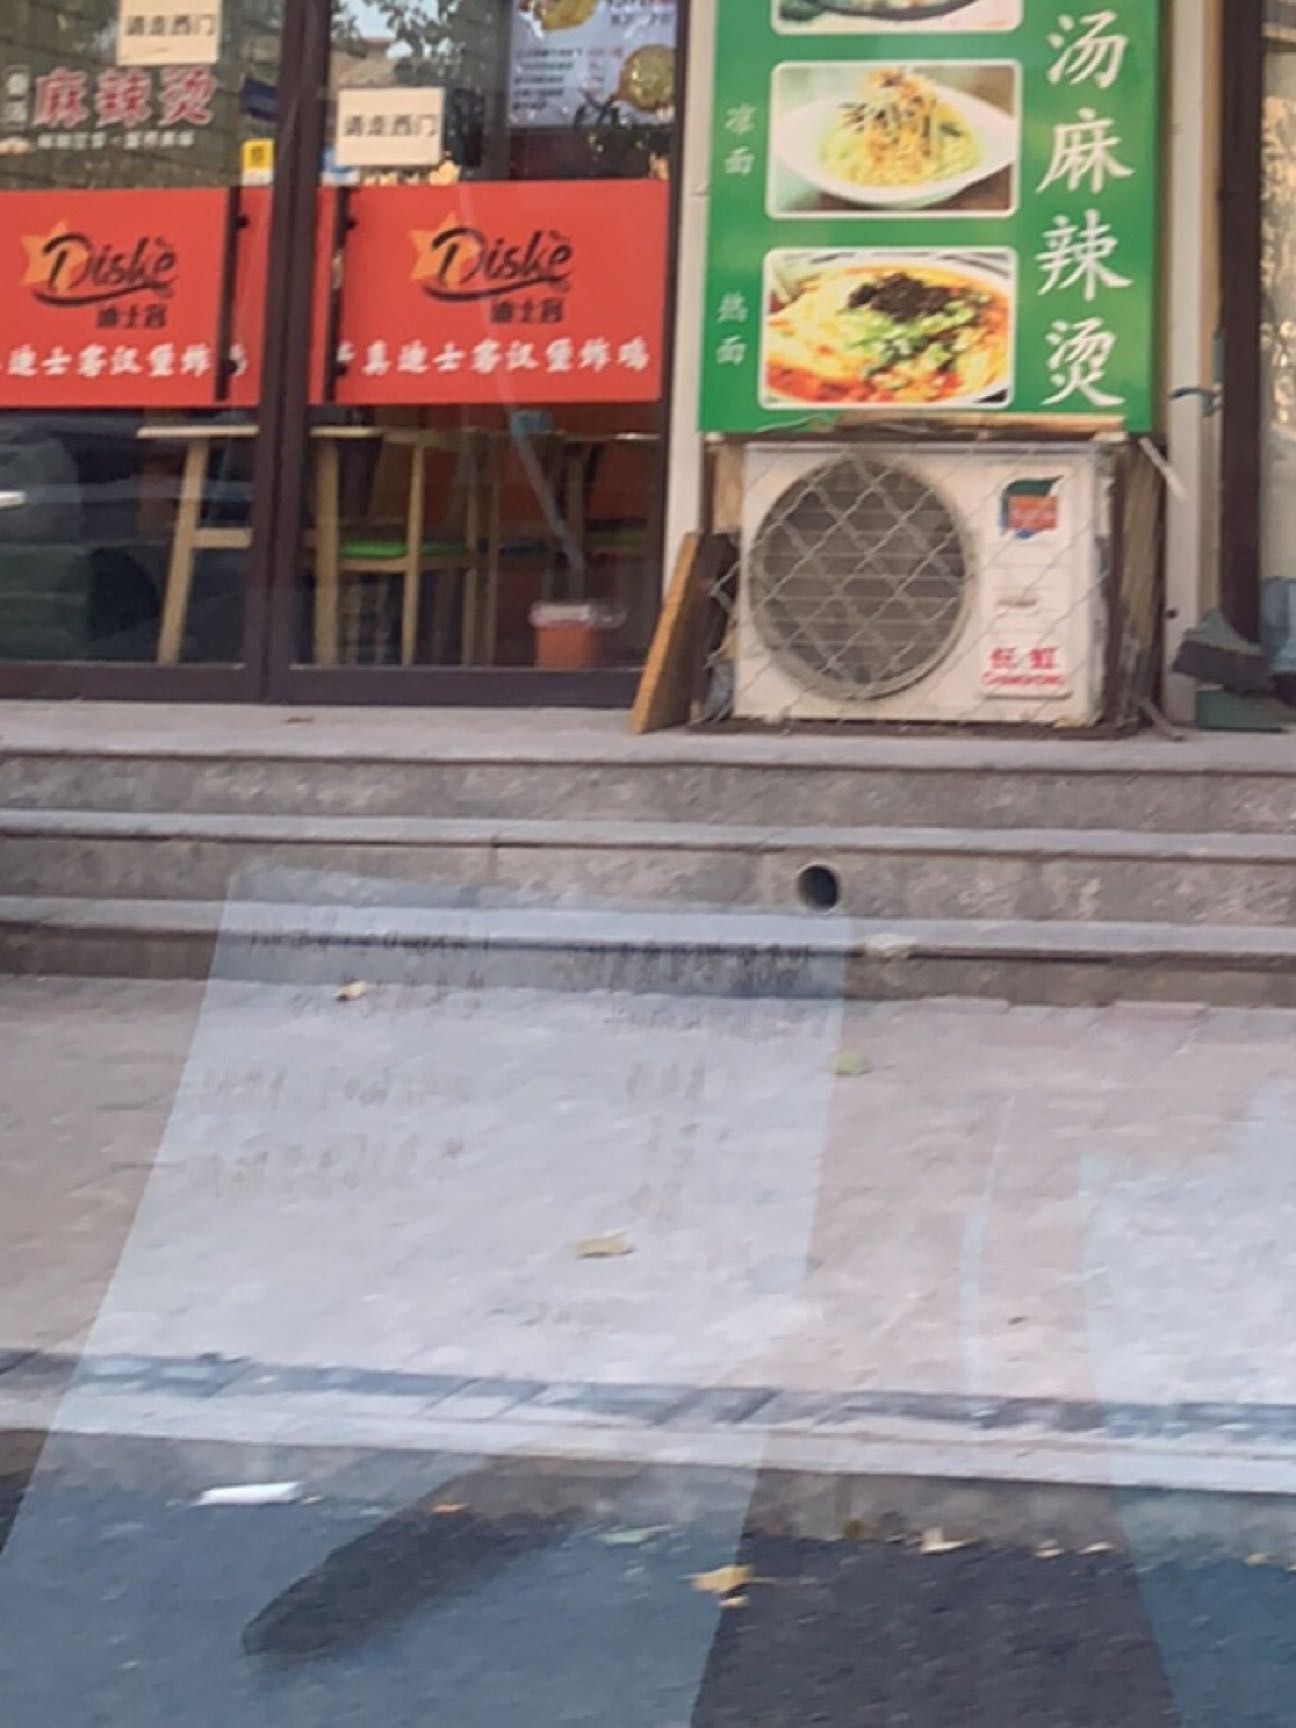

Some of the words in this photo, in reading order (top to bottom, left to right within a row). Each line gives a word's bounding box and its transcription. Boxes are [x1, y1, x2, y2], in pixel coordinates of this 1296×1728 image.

[34, 66, 215, 129] 麻辣烫
[724, 103, 758, 176] 凉面
